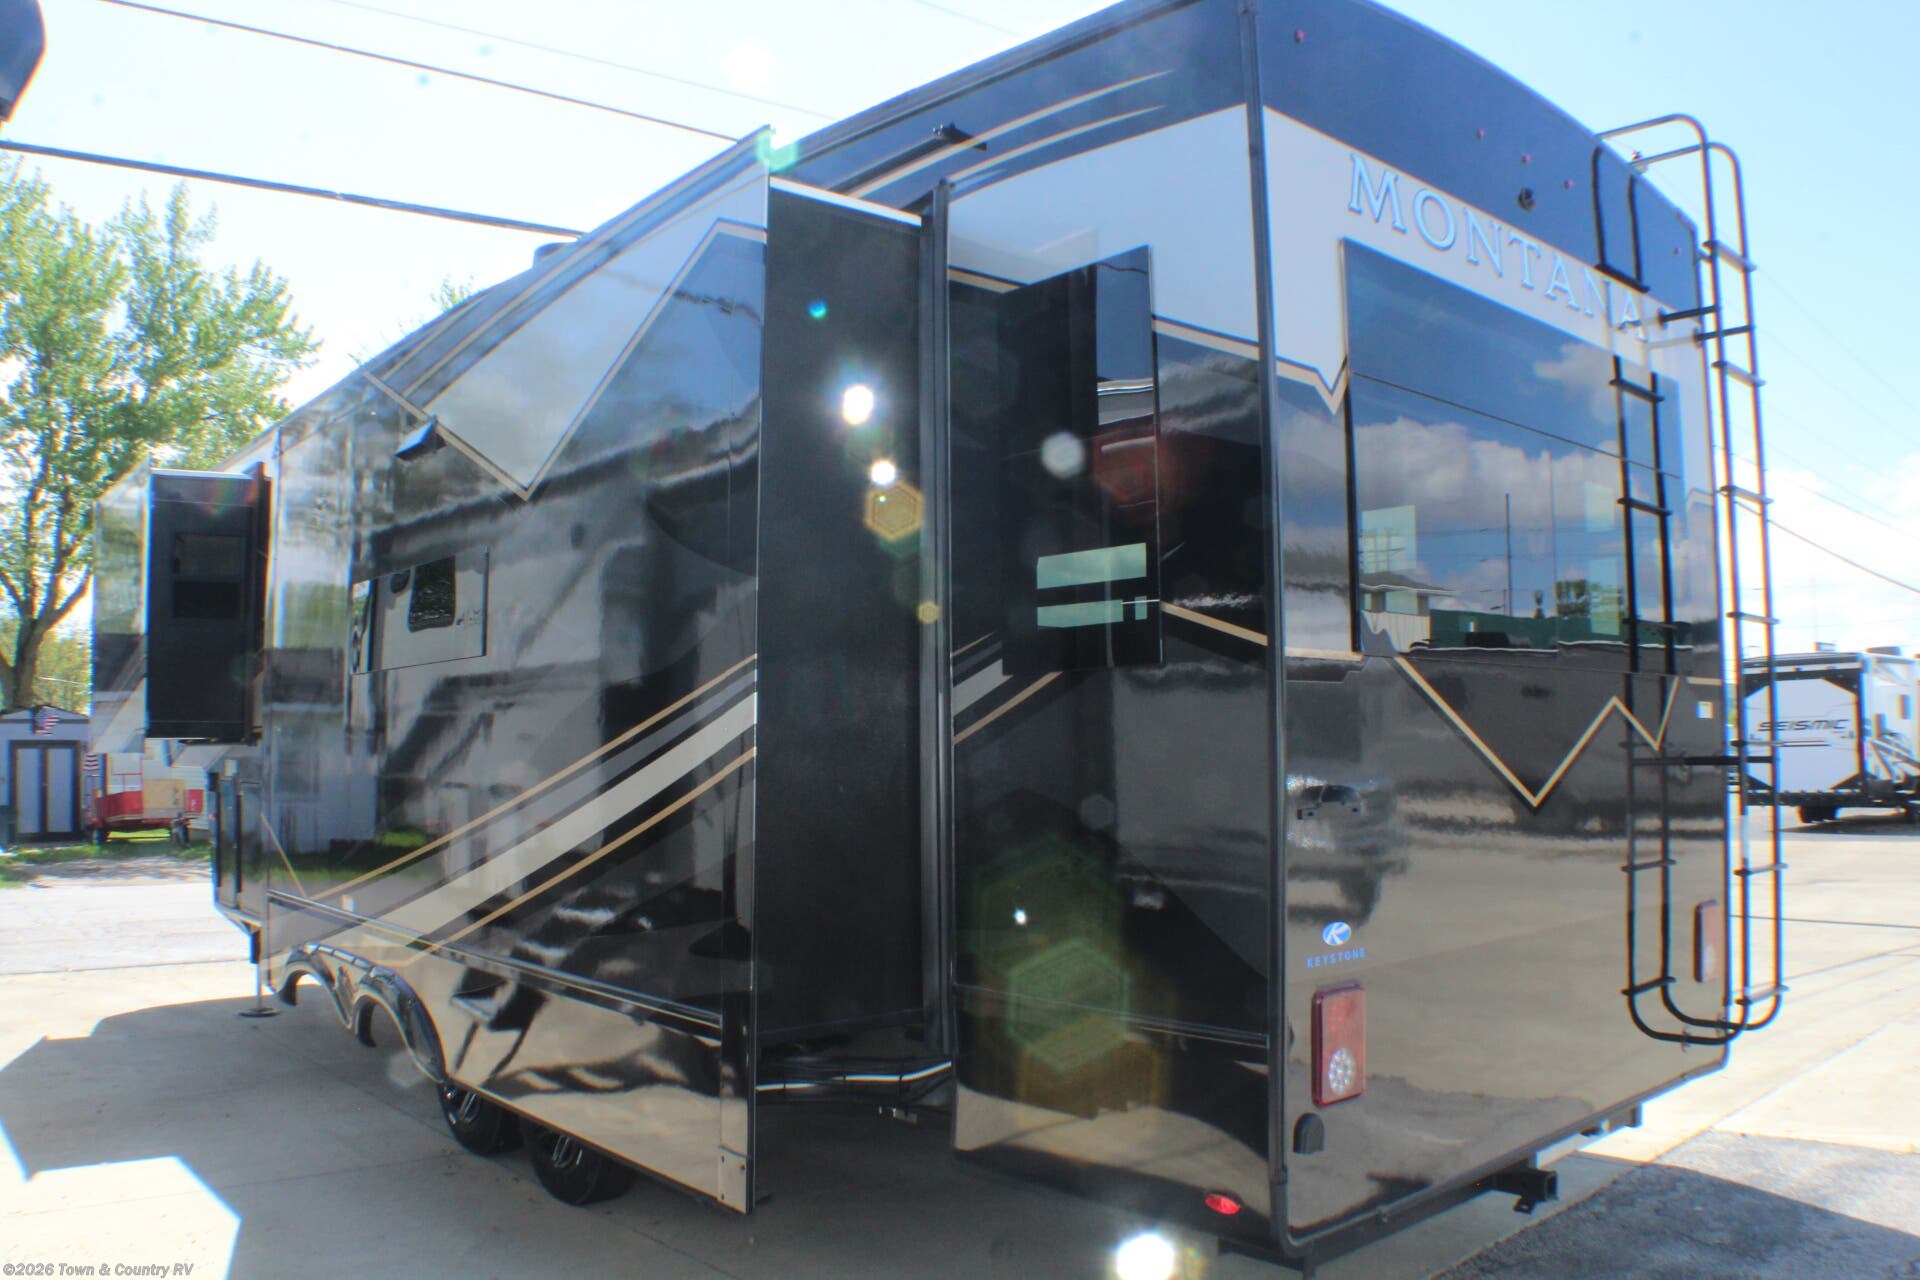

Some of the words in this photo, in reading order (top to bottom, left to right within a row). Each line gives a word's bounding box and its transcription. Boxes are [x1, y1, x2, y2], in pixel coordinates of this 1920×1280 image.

[1348, 153, 1649, 342] MONTANA
[1757, 719, 1849, 732] SEISMIC
[1306, 947, 1366, 968] KEYSTONE
